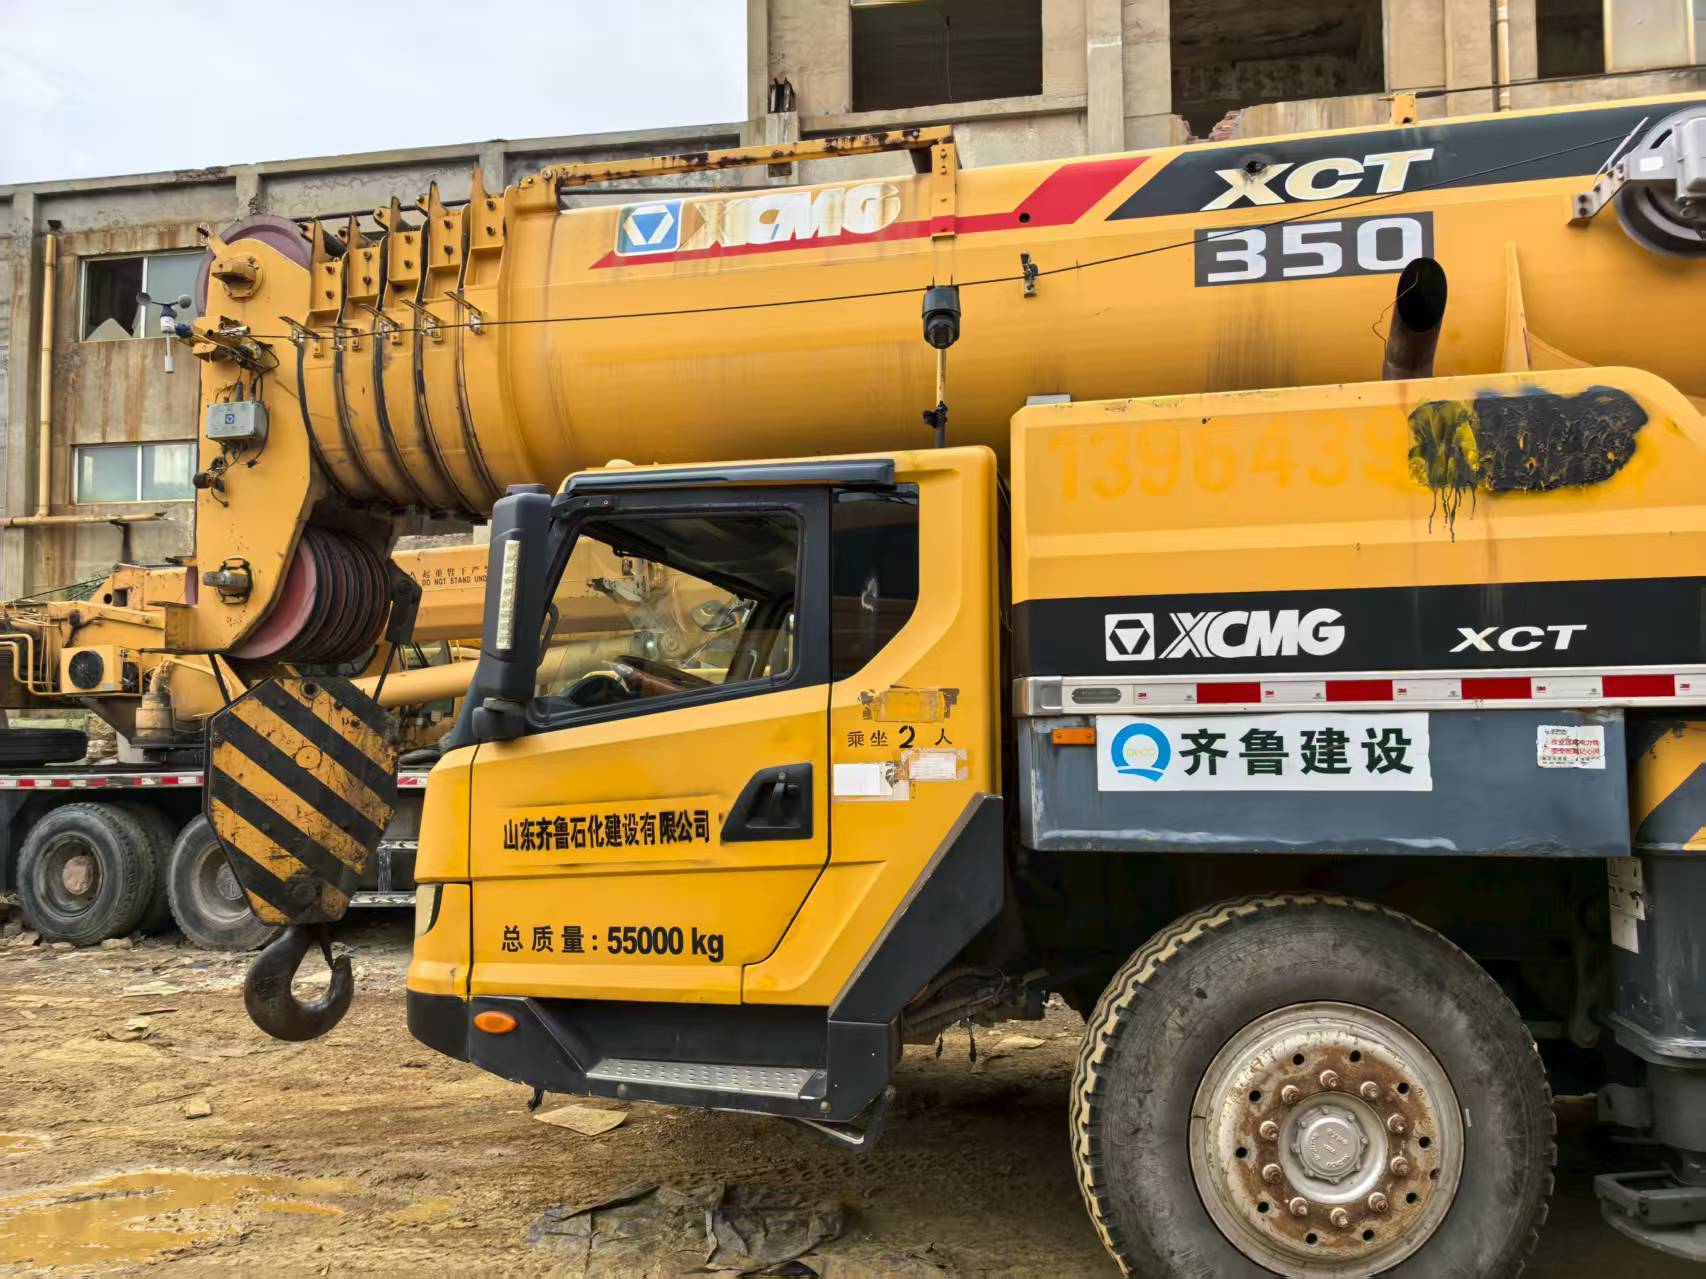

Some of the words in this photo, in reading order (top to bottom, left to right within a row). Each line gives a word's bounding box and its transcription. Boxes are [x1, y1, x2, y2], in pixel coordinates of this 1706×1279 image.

[1200, 148, 1435, 211] XCT
[678, 182, 901, 253] XCMG
[1207, 217, 1423, 283] 350
[434, 578, 446, 586] NOT
[450, 576, 471, 585] STAND
[1158, 608, 1346, 660] XCMG
[1449, 624, 1588, 654] XCT
[1178, 727, 1415, 777] 齐鲁建设
[503, 809, 710, 851] 山东齐鲁石化建设有限公司
[607, 925, 684, 956] 55000
[691, 927, 724, 963] kg
